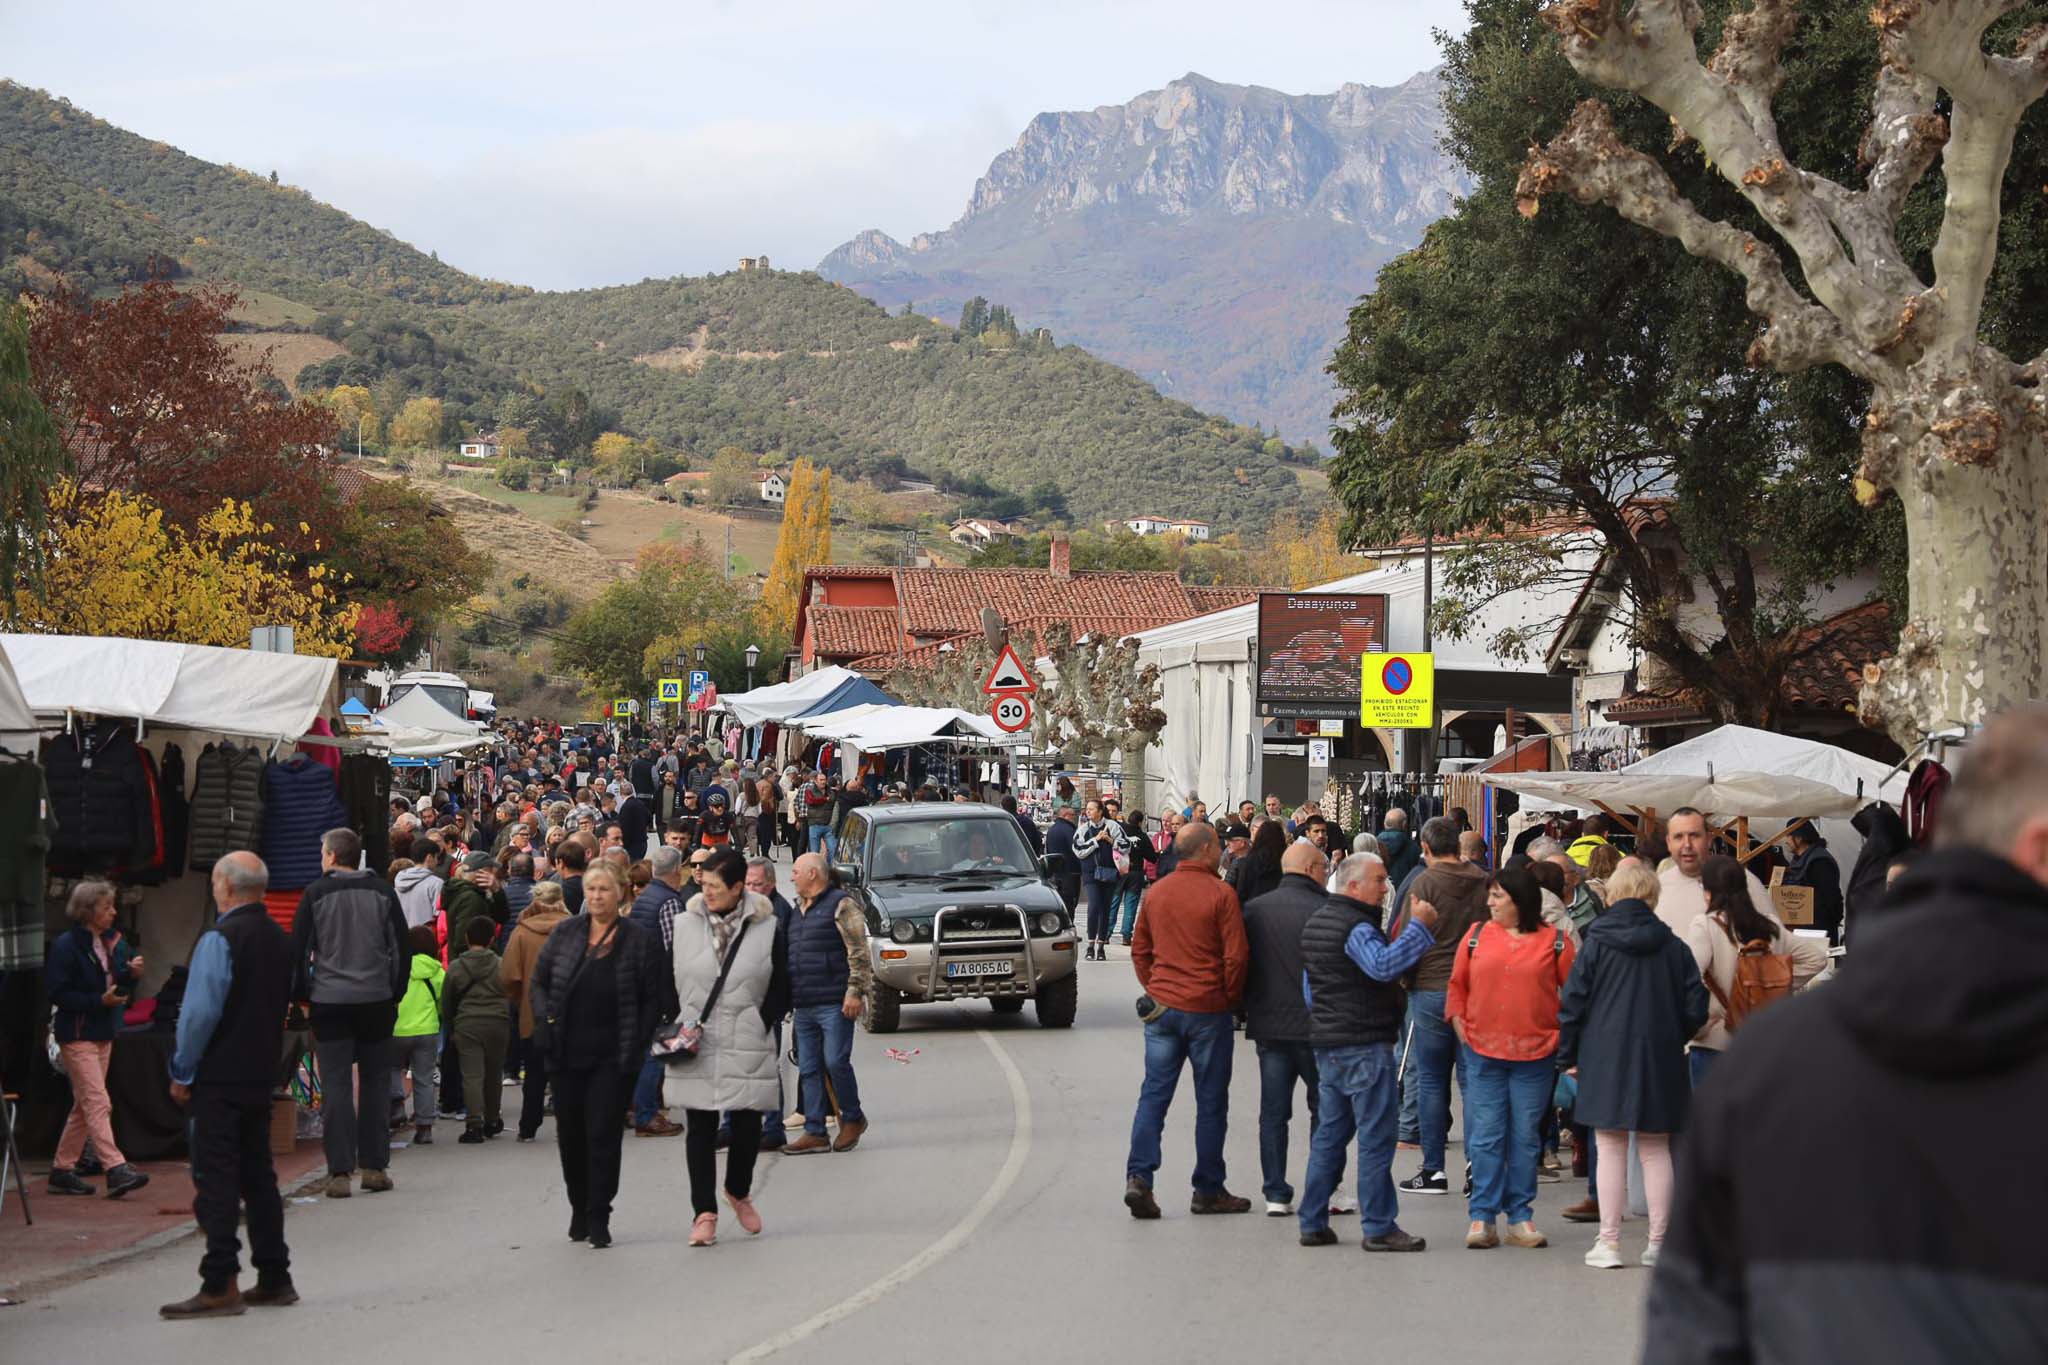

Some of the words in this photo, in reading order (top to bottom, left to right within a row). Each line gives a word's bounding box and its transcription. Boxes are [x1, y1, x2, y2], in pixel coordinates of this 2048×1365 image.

[1288, 598, 1357, 611] Desayunos
[693, 672, 703, 685] P
[1000, 705, 1022, 717] 30
[1300, 708, 1347, 716] Ayuntamiento
[968, 963, 996, 974] 8065
